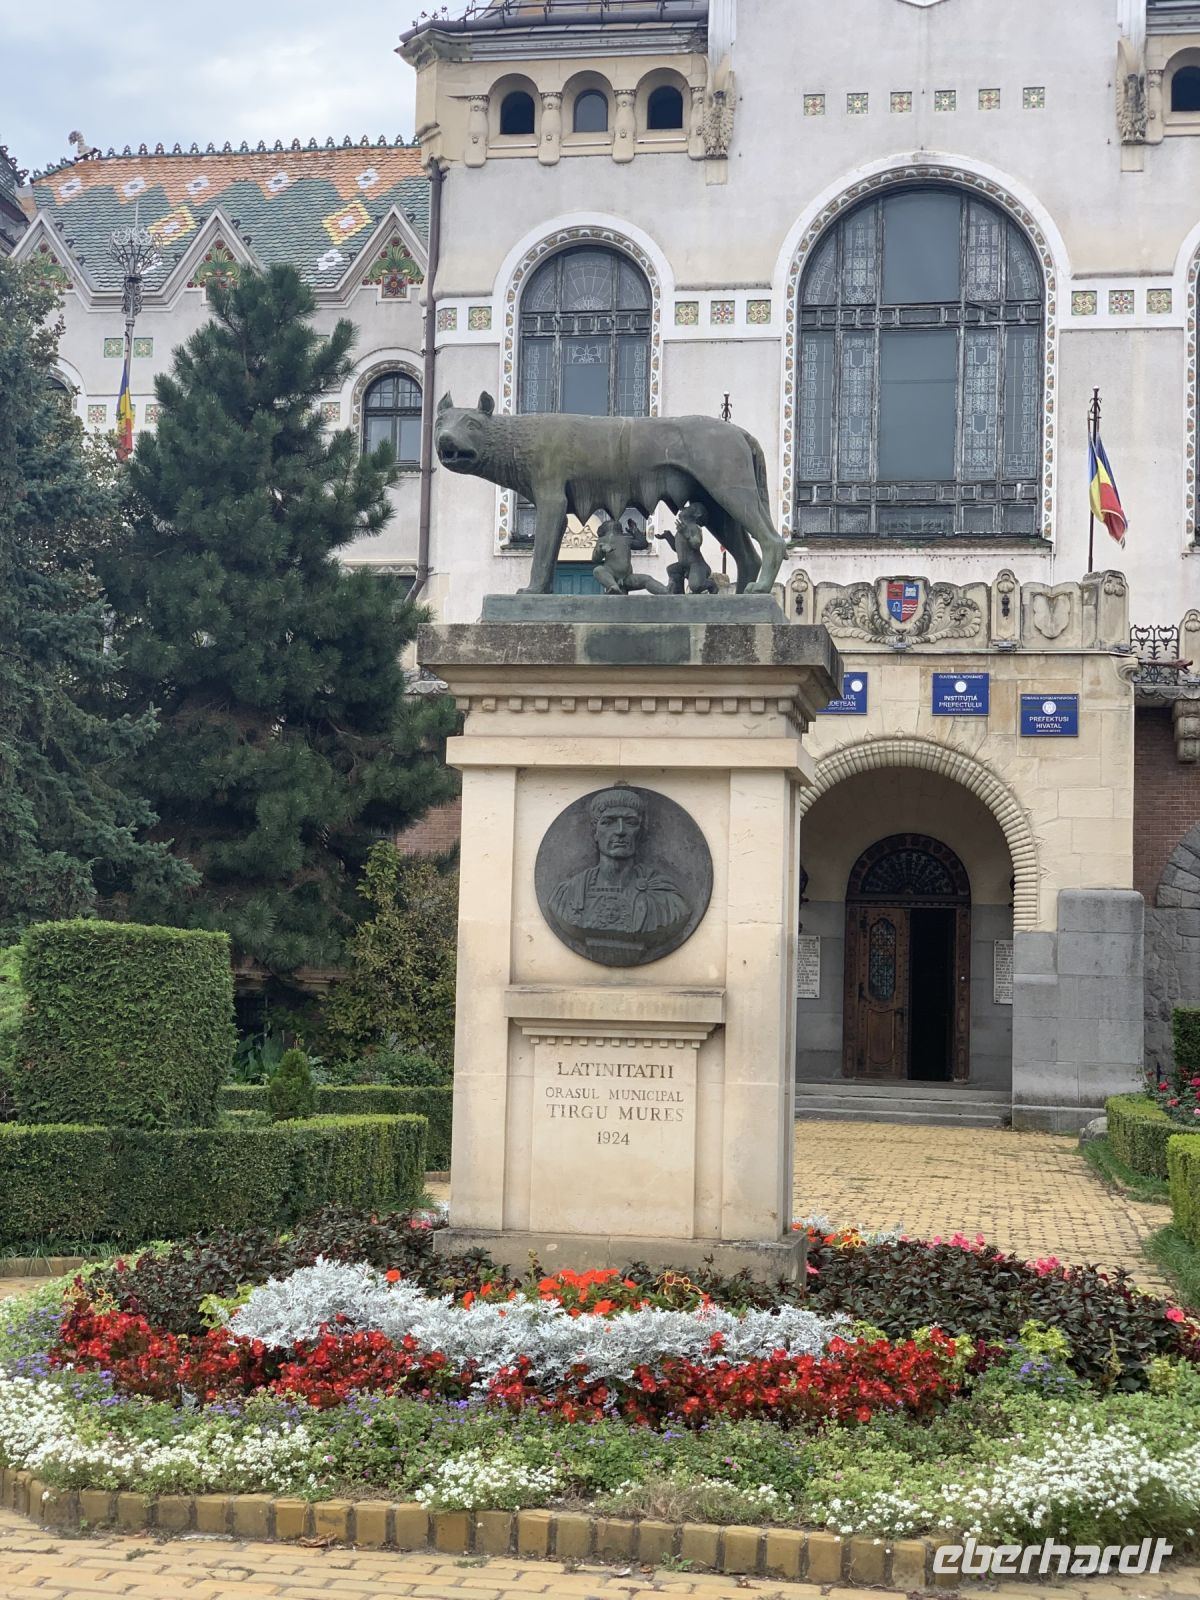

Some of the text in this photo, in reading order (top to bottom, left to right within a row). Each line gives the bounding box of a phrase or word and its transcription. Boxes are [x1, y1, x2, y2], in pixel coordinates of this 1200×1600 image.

[557, 1062, 674, 1079] LATINITATII
[545, 1086, 684, 1102] ORASUL MUNICIPAL
[546, 1103, 684, 1122] TIRGU MURES
[597, 1130, 631, 1146] 1924
